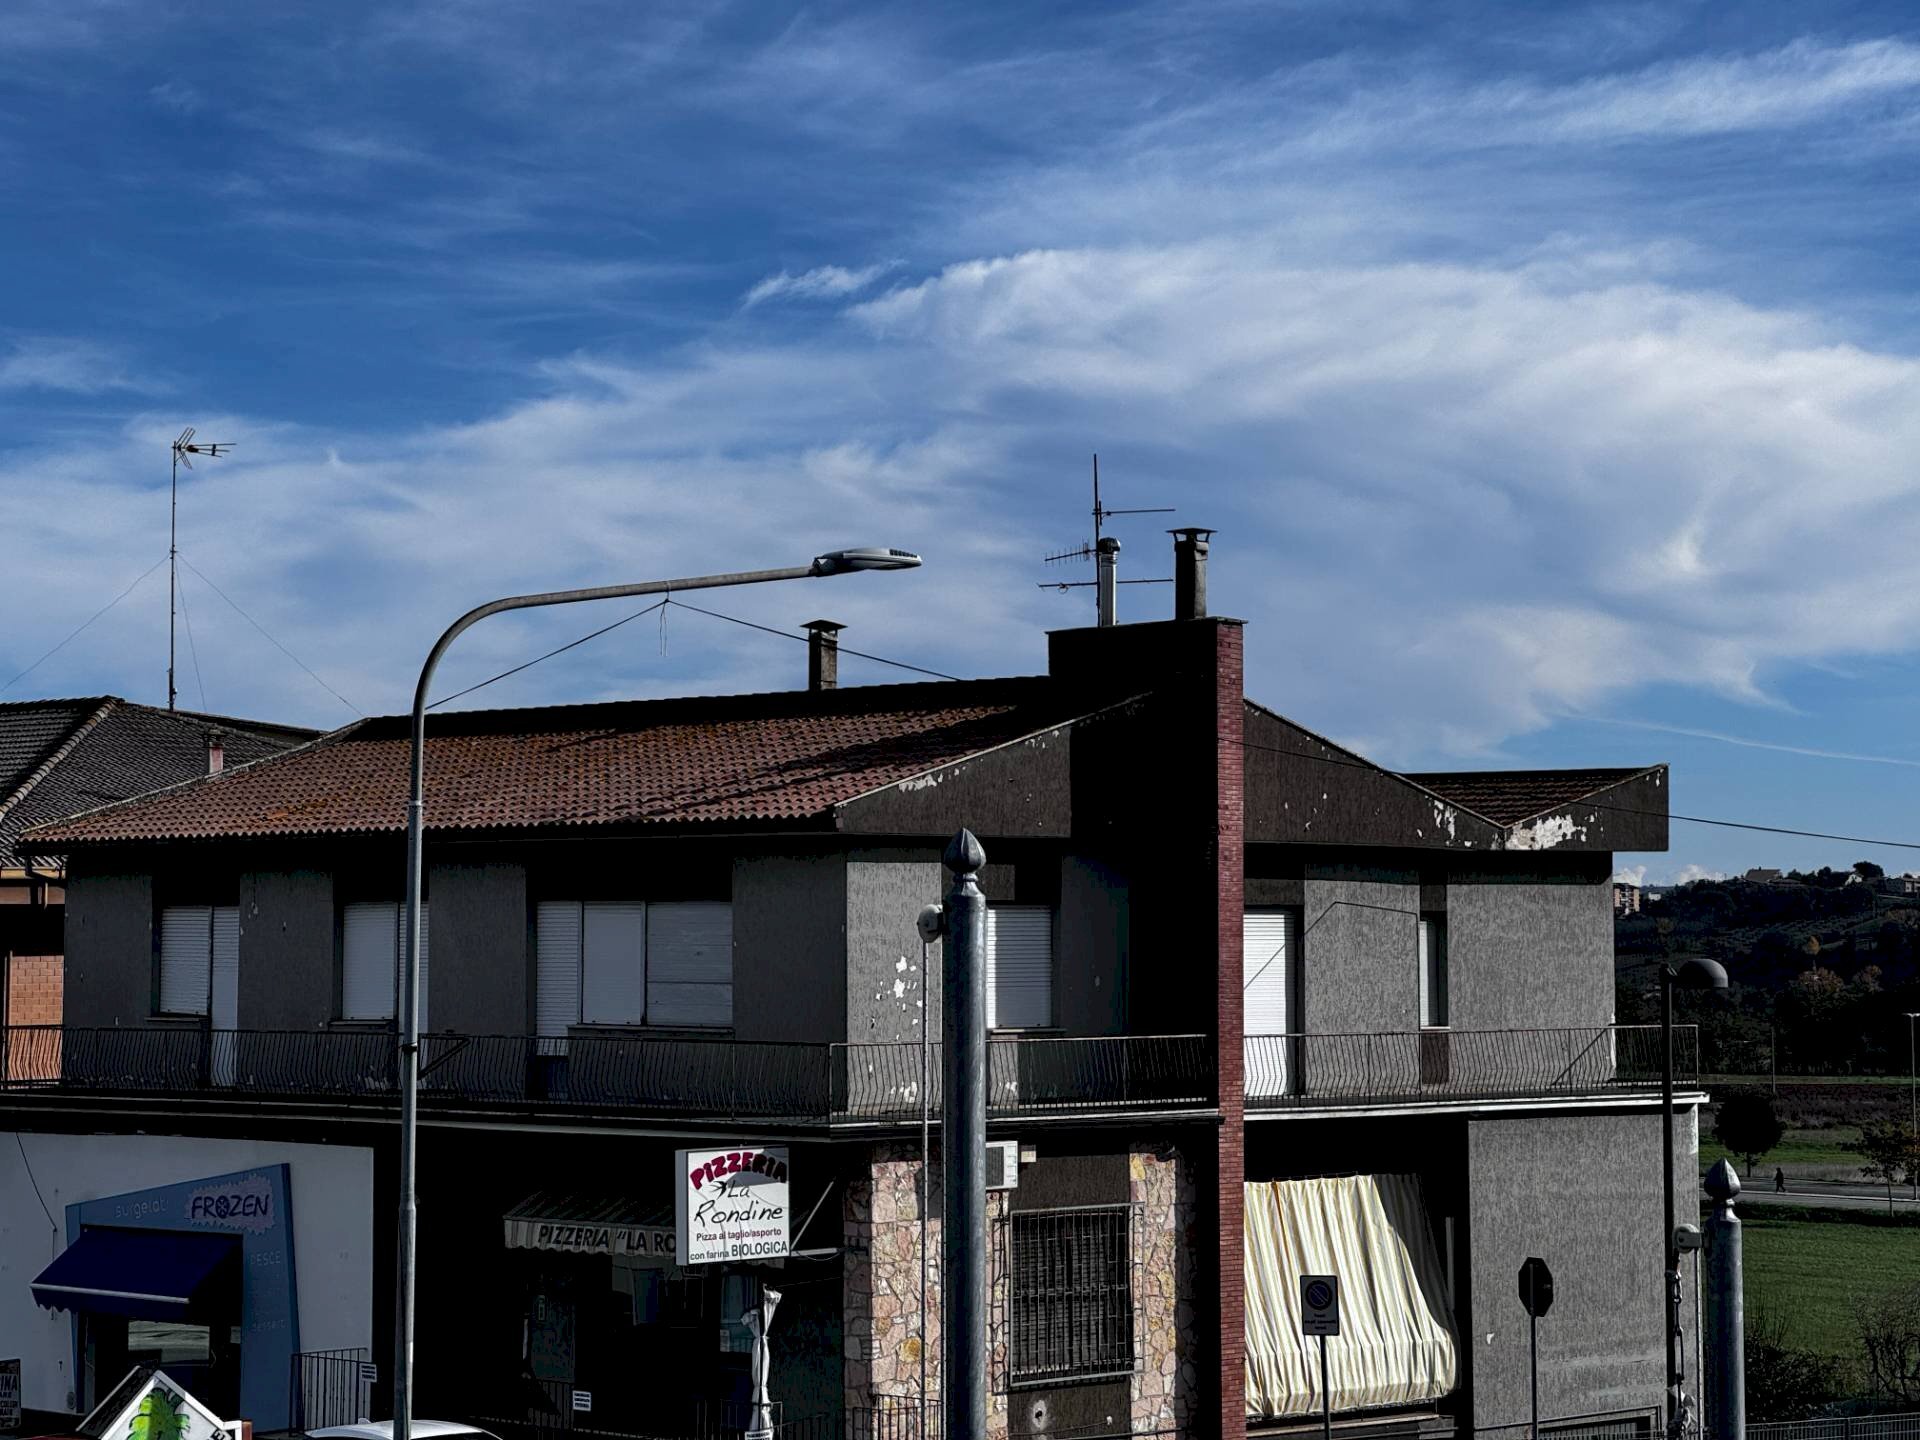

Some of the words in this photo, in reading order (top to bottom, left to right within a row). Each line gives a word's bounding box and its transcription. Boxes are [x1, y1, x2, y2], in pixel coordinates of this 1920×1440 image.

[690, 1152, 787, 1190] PIZZERIA
[728, 1180, 750, 1198] La
[191, 1195, 270, 1219] FROZEN
[694, 1199, 783, 1228] Rondine
[538, 1225, 609, 1248] PIZZERIA
[696, 1232, 717, 1242] Pizza
[719, 1231, 726, 1240] al
[690, 1251, 705, 1261] con
[706, 1249, 730, 1260] farina
[731, 1241, 788, 1257] BIOLOGICA
